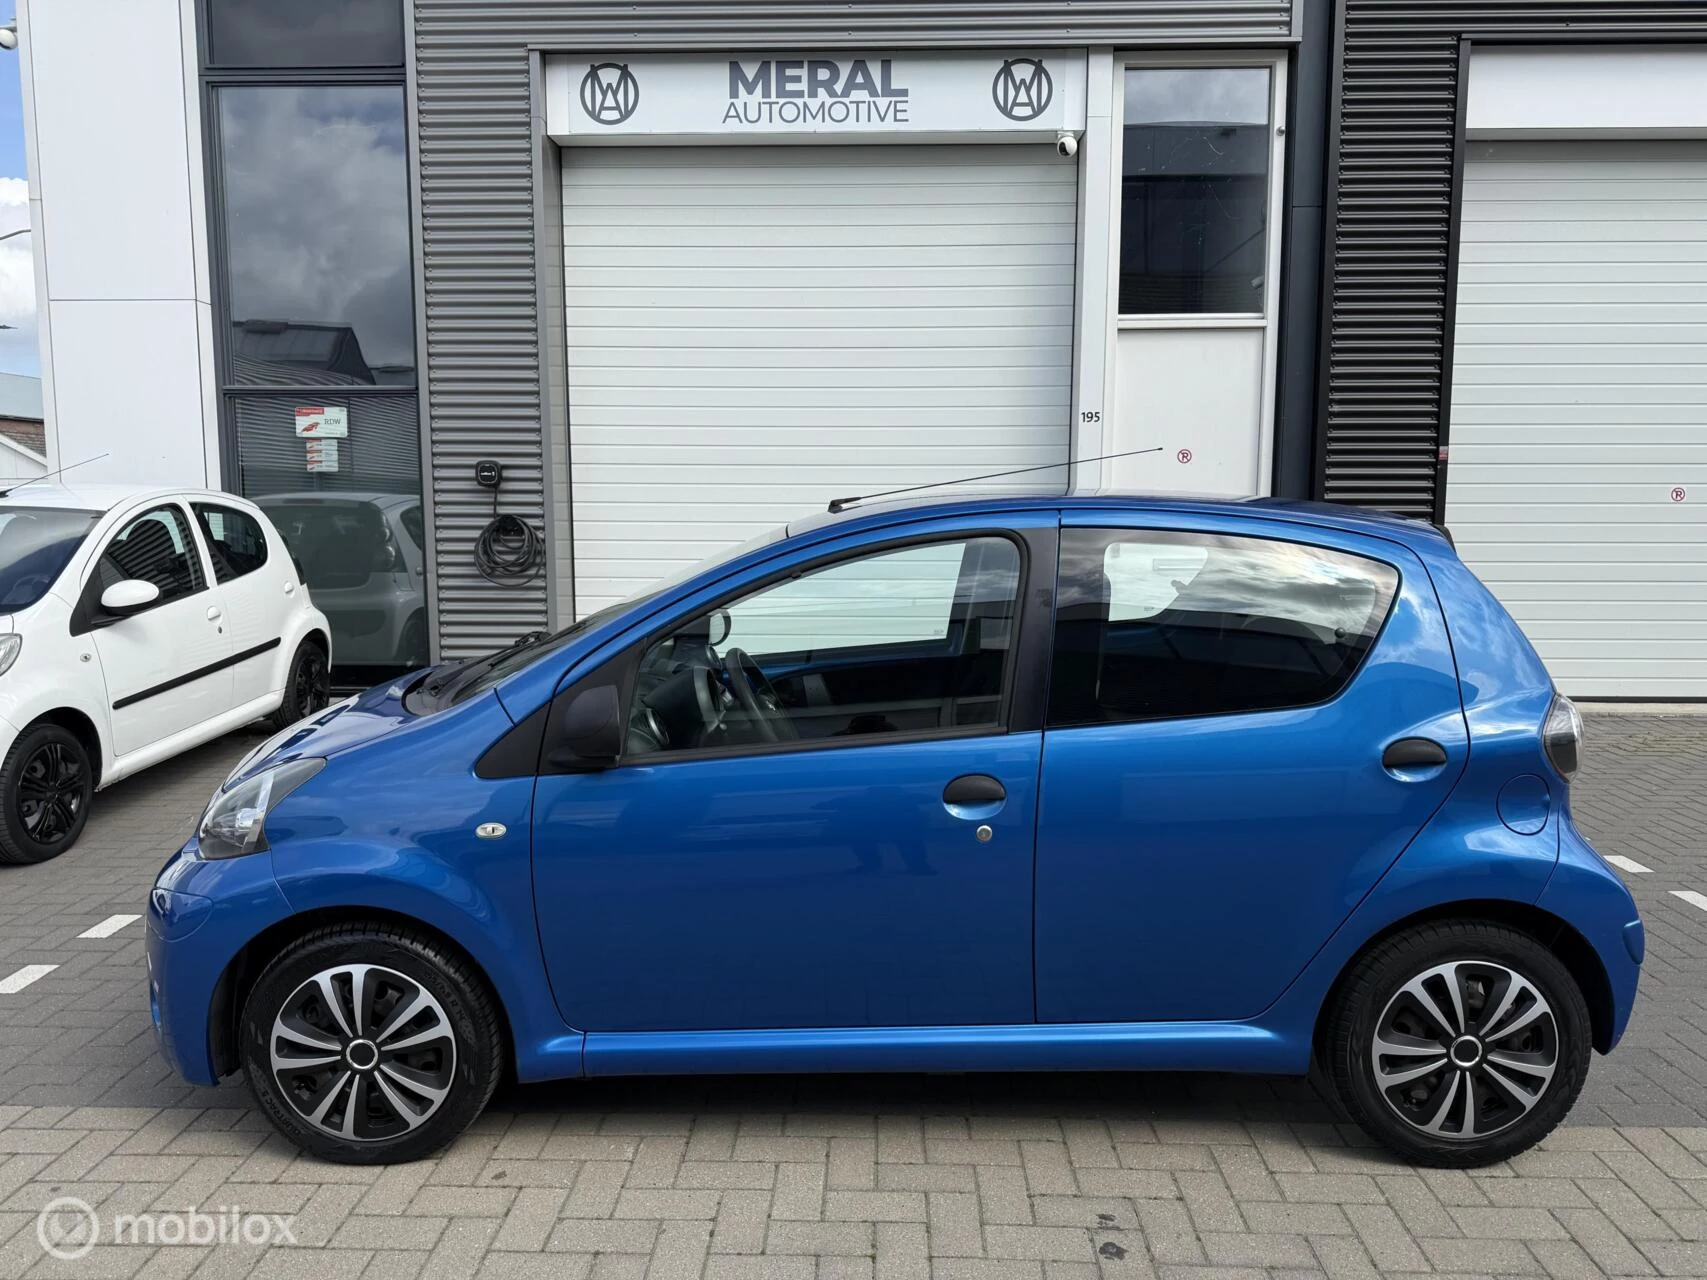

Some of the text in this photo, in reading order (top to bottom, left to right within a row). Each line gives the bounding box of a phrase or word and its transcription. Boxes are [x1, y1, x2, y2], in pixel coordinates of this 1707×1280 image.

[729, 59, 909, 99] MERAL
[722, 100, 909, 123] AUTOMOTIVE
[1081, 411, 1101, 423] 195
